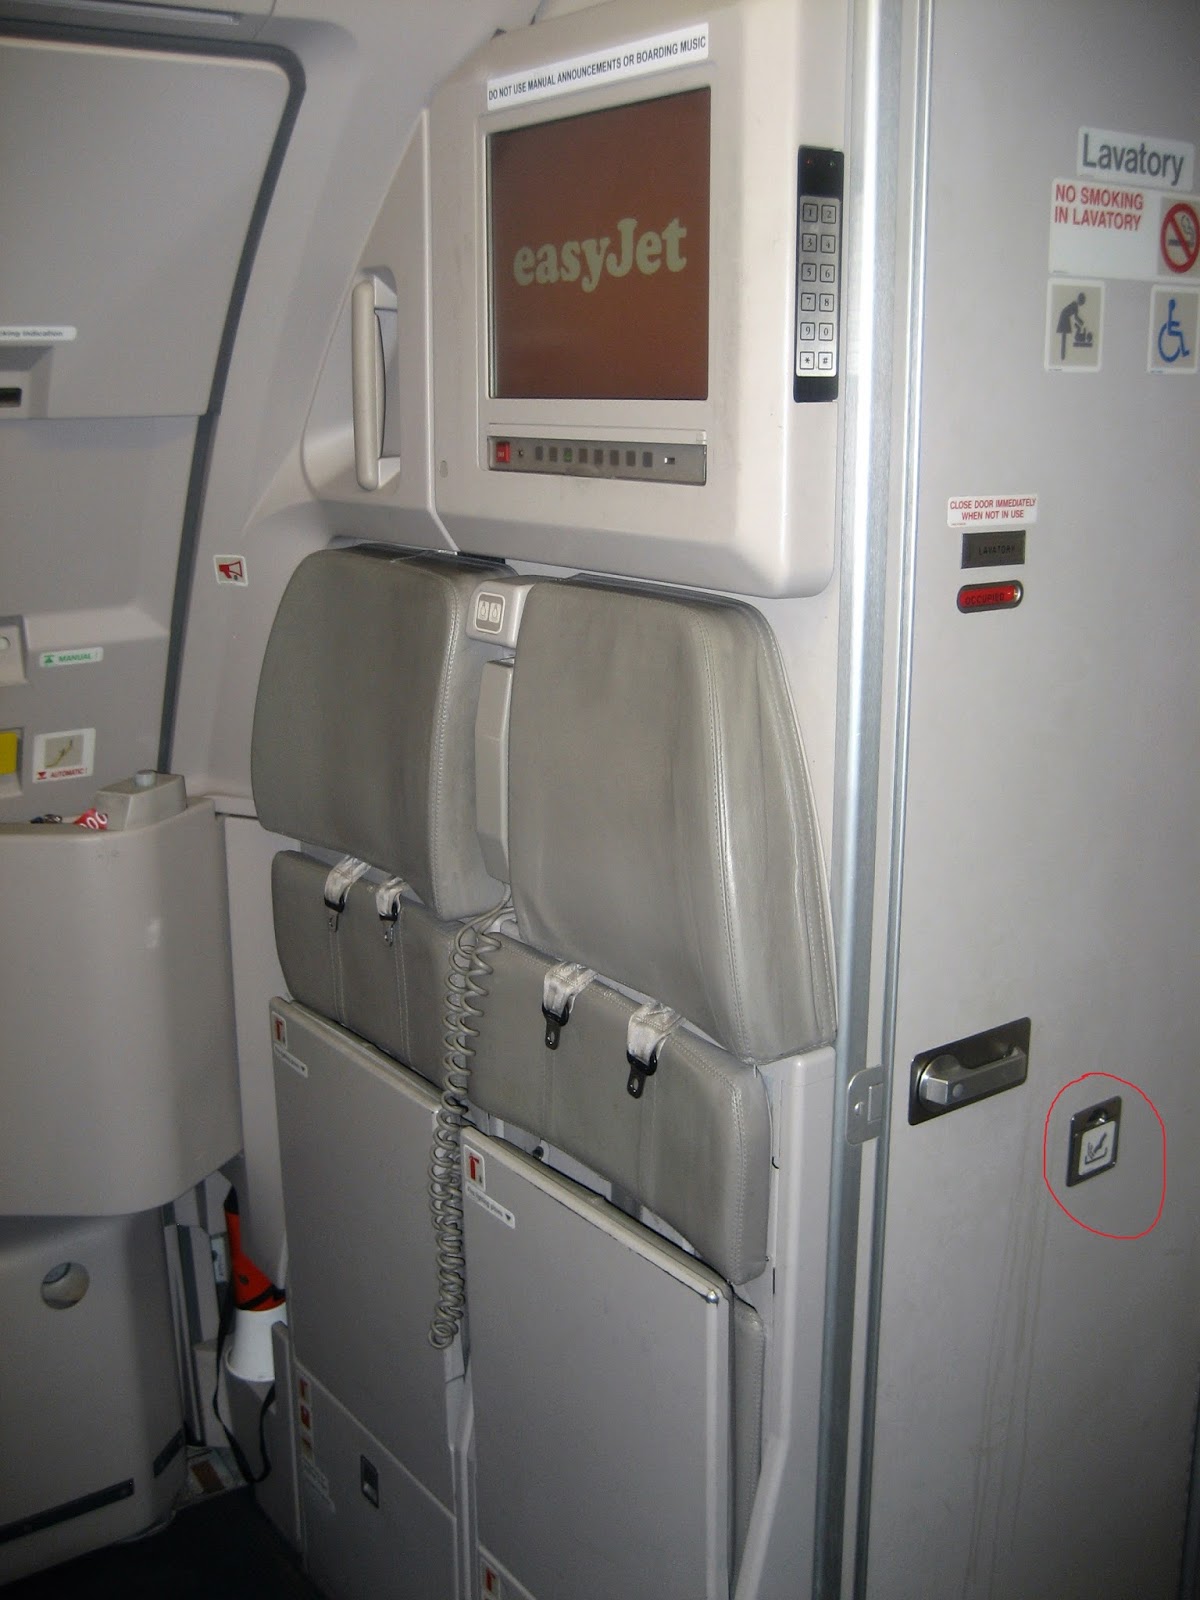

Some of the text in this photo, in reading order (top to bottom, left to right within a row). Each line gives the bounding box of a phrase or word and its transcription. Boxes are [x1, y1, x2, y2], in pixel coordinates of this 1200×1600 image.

[488, 36, 706, 100] DO NOT USE MANUAL ANNOUNCEMENTS OR BOARDING MUSIC
[1082, 133, 1185, 187] Lavatory
[1055, 184, 1144, 211] NO SMOKING
[1054, 206, 1142, 232] IN LAVATORY
[513, 217, 687, 293] easyJet
[950, 497, 1036, 510] CLOSE DOOR IMMEDIATELY
[961, 509, 1024, 520] WHEN NOT IN USE
[978, 545, 1016, 556] LAVATORY
[964, 592, 1005, 606] OCCUPIED
[58, 653, 91, 662] MANUAL
